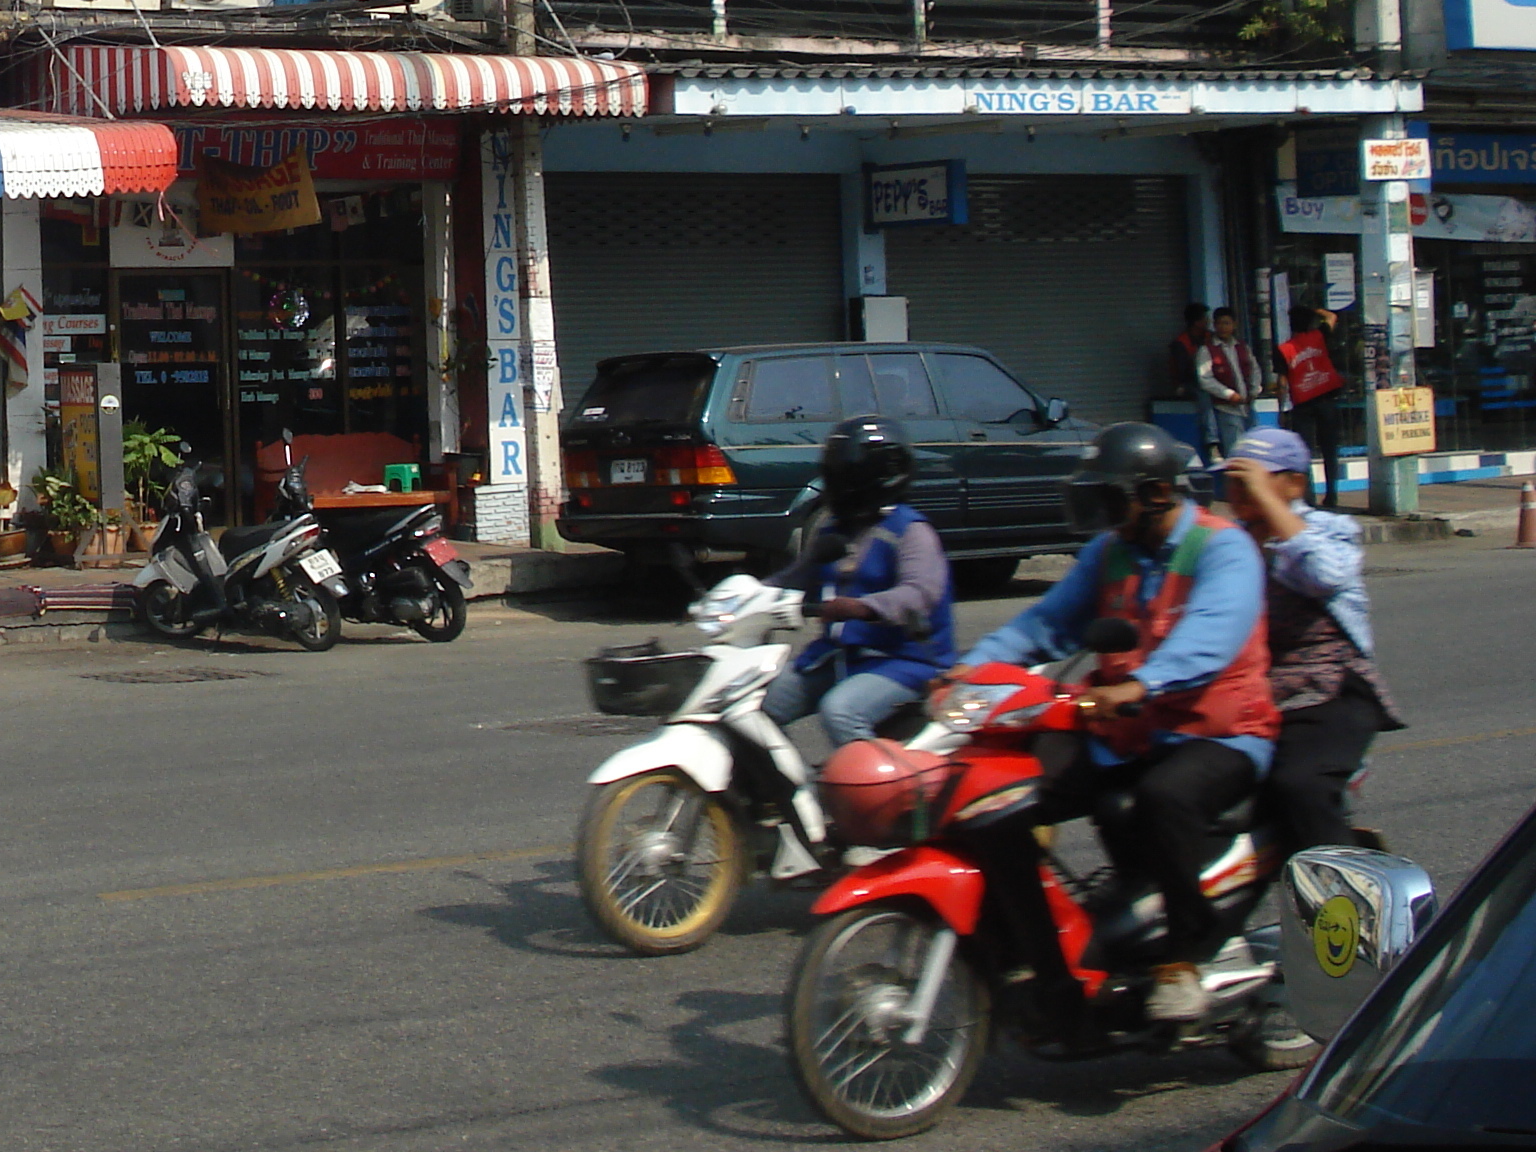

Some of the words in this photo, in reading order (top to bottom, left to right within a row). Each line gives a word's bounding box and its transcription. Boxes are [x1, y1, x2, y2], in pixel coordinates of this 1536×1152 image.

[973, 92, 1076, 112] NING'S
[1091, 93, 1159, 112] BAR
[362, 154, 372, 170] &
[376, 153, 417, 172] Training
[421, 154, 454, 171] Center
[491, 132, 516, 335] NING'S
[57, 316, 100, 330] Courses
[498, 348, 524, 476] BAR
